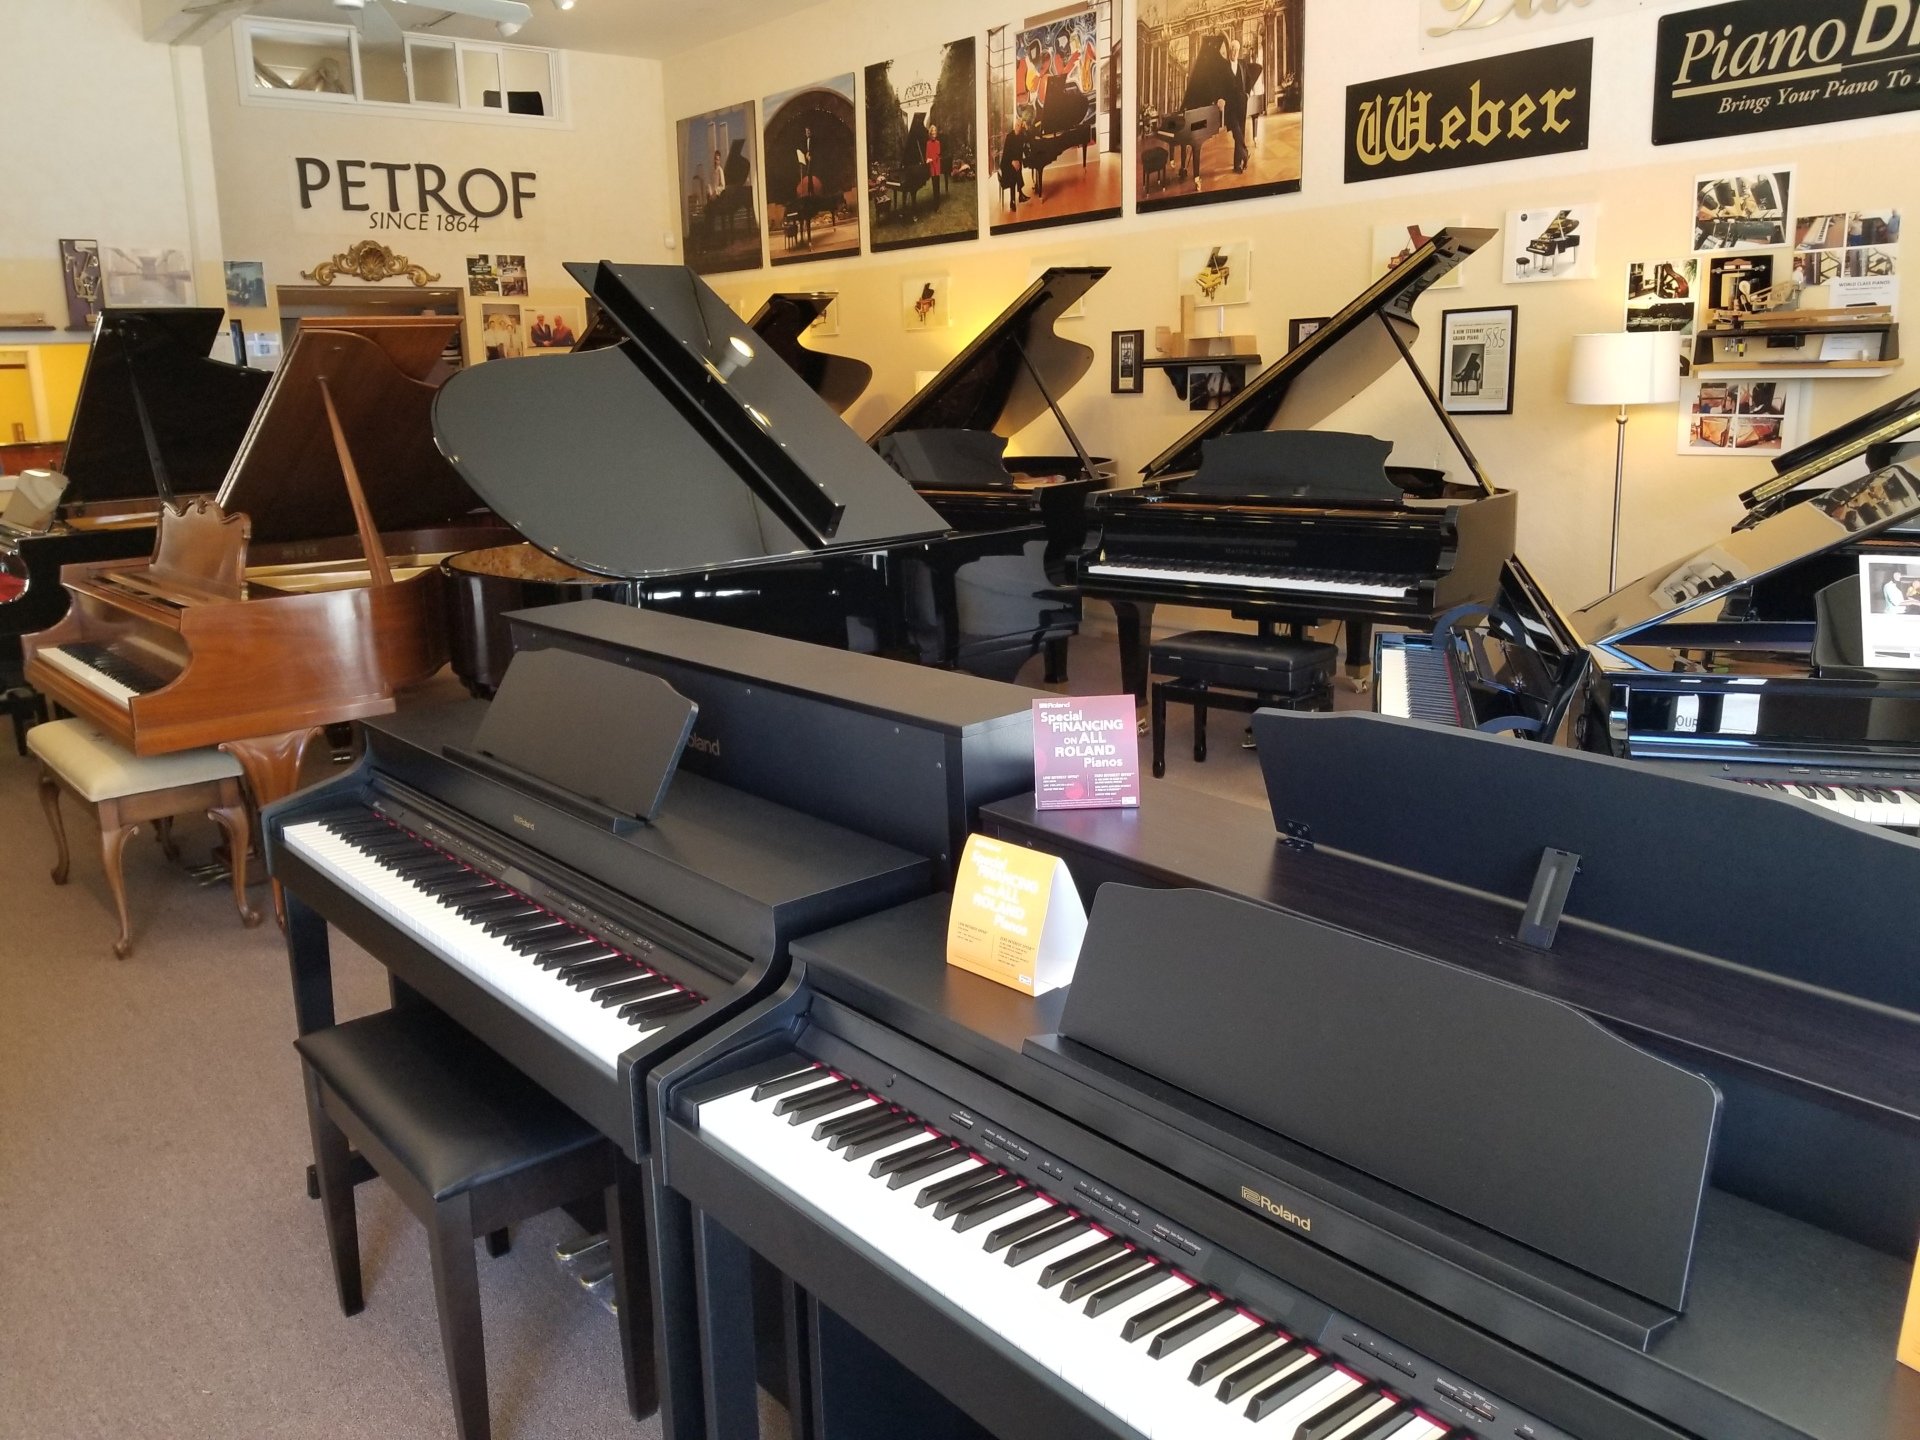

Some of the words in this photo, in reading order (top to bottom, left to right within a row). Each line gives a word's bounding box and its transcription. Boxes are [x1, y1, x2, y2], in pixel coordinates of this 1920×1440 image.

[1717, 96, 1771, 114] Brings
[1777, 86, 1820, 106] Your
[1823, 77, 1879, 99] Piano
[1887, 69, 1911, 89] To
[1356, 79, 1577, 166] Weber
[295, 157, 537, 219] PETROF
[369, 212, 429, 231] SINCE
[436, 213, 480, 232] 1864
[1040, 710, 1082, 725] Special
[1052, 719, 1124, 732] FINANCING
[688, 733, 720, 756] oland
[1063, 737, 1077, 745] ON
[1079, 731, 1107, 744] ALL
[1054, 745, 1116, 757] ROLAND
[1083, 757, 1123, 768] Pianos
[1261, 1196, 1310, 1231] Roland
